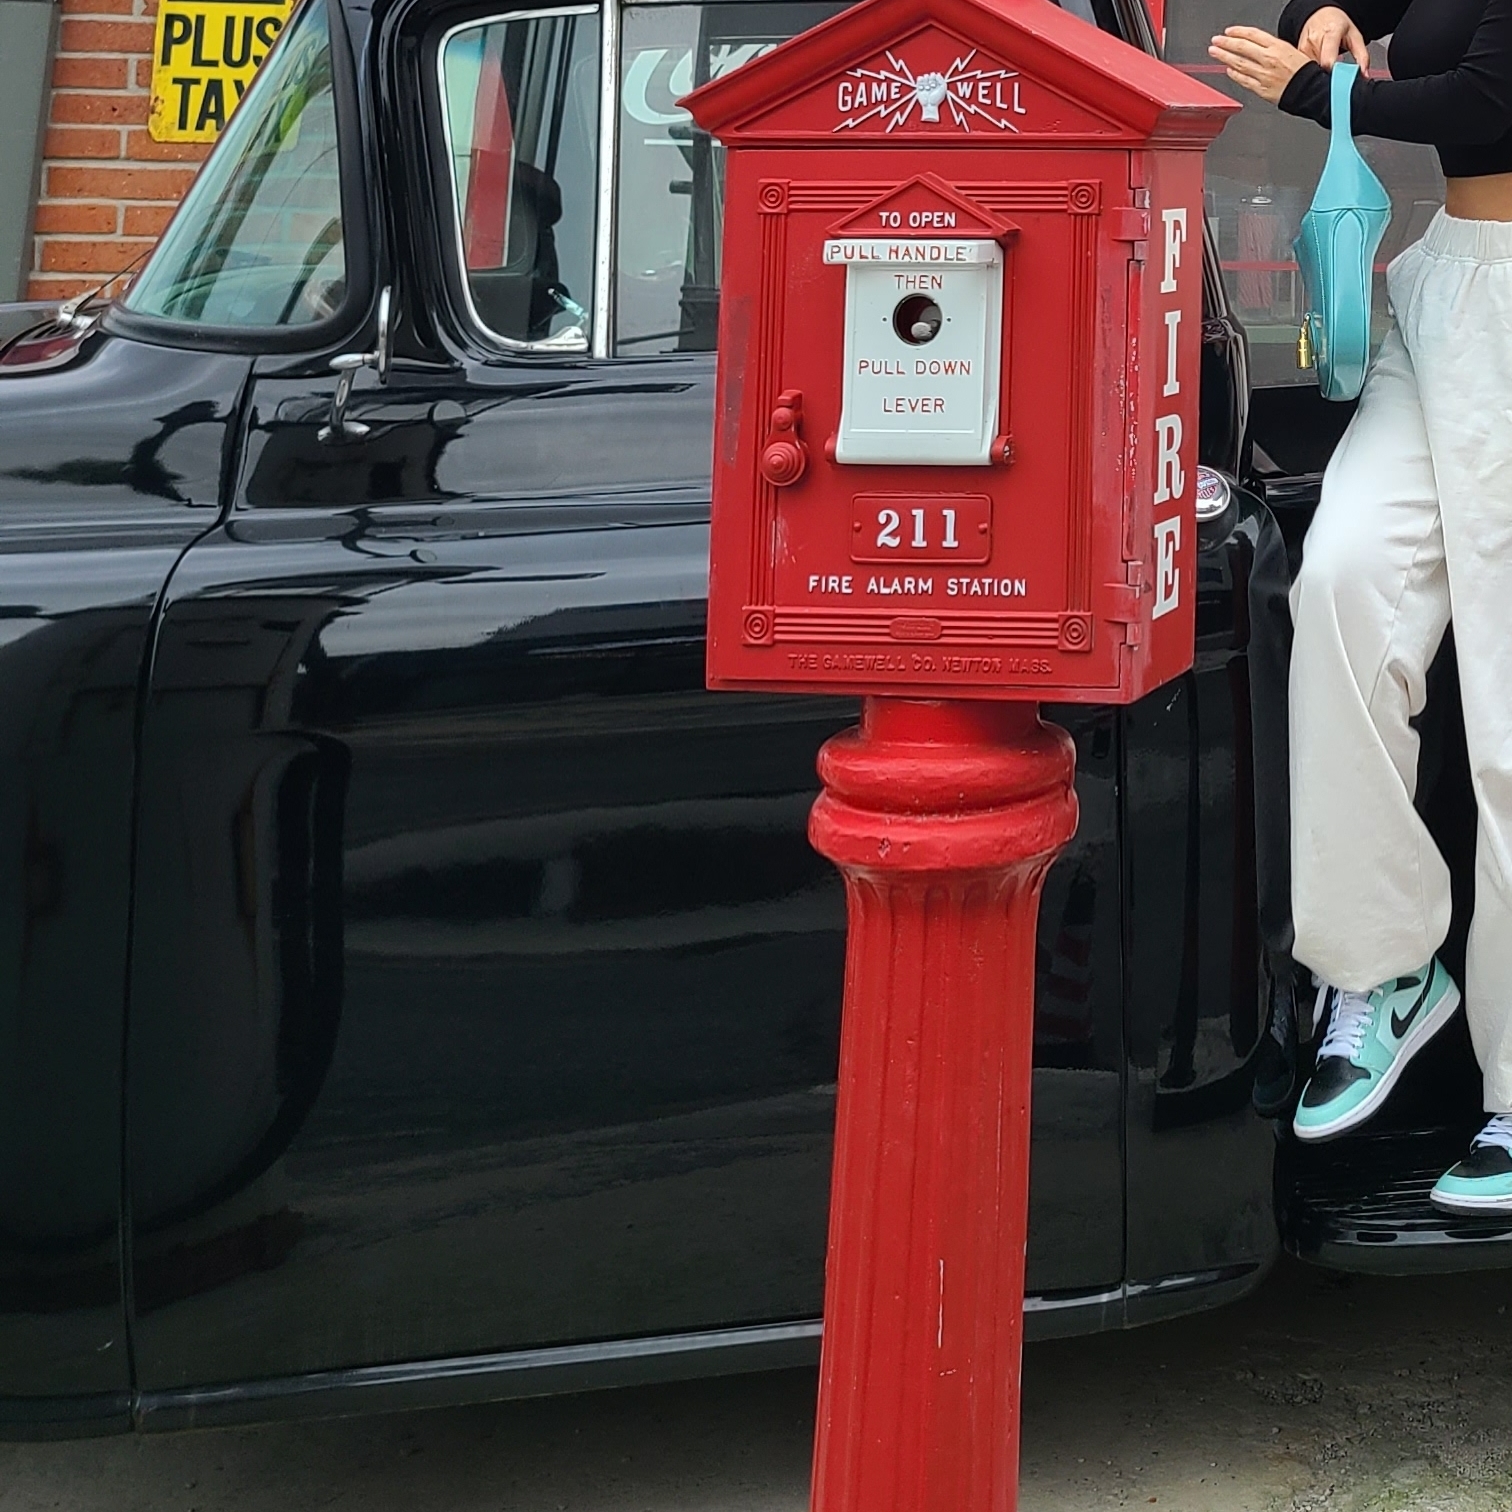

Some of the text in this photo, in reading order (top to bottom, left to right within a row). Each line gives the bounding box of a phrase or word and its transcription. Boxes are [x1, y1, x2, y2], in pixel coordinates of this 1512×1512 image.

[161, 13, 284, 69] PLUS
[838, 81, 1026, 114] GAME WELL
[879, 211, 957, 229] TO OPEN
[830, 244, 967, 263] PULL HANDLE
[894, 274, 943, 290] THEN
[858, 359, 972, 376] PULL DOWN
[883, 398, 945, 414] LEVER
[1152, 207, 1188, 620] FIRE
[876, 508, 960, 549] 211
[808, 575, 1027, 597] FIRE ALARM STATION
[788, 653, 819, 670] THE
[822, 653, 906, 672] GAMEWELL
[942, 655, 1003, 675] NEWTON
